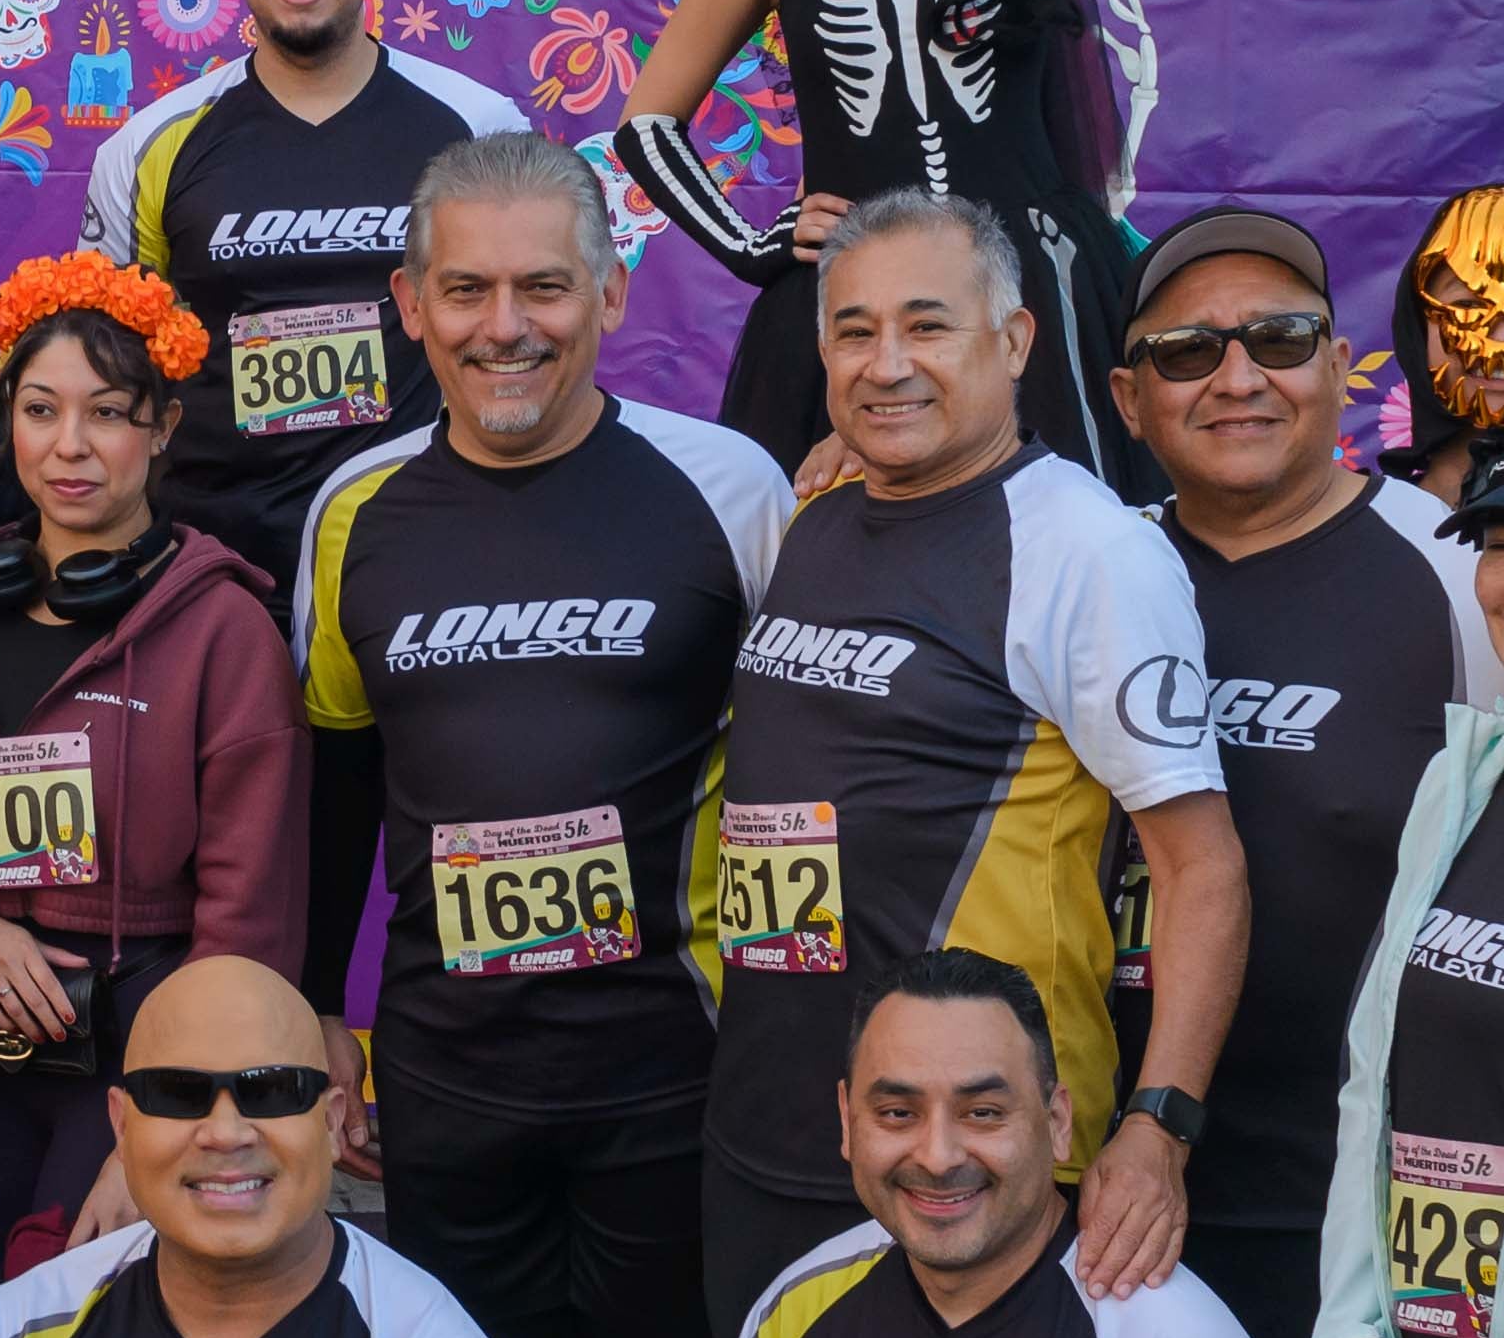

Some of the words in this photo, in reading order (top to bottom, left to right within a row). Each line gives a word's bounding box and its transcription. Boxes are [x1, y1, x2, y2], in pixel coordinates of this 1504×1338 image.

[208, 241, 296, 261] TOYOTA
[284, 318, 335, 331] MUERTOS
[335, 308, 357, 324] 5k
[240, 340, 379, 409] 3804
[286, 410, 340, 426] LONGO
[385, 598, 657, 656] LONGO
[385, 643, 489, 673] TOYOTA
[491, 638, 646, 661] LEXUS
[741, 614, 917, 677] LONGO
[735, 650, 785, 680] TOYOTA
[786, 663, 891, 697] LEXUS
[74, 691, 149, 713] ALPHALTE
[36, 741, 61, 760] 5k
[482, 829, 503, 840] Day
[517, 824, 532, 835] the
[534, 822, 560, 832] Dead
[564, 818, 592, 839] 5k
[780, 812, 808, 831] 5k
[497, 832, 562, 848] MUERTOS
[445, 859, 624, 942] 1636
[719, 852, 834, 933] 2512
[508, 948, 576, 966] LONGO
[742, 946, 787, 963] LONGO
[1433, 1147, 1458, 1160] Dead
[1403, 1157, 1458, 1174] MUERTOS
[1460, 1153, 1492, 1177] 5k
[1398, 1301, 1457, 1327] LONGO
